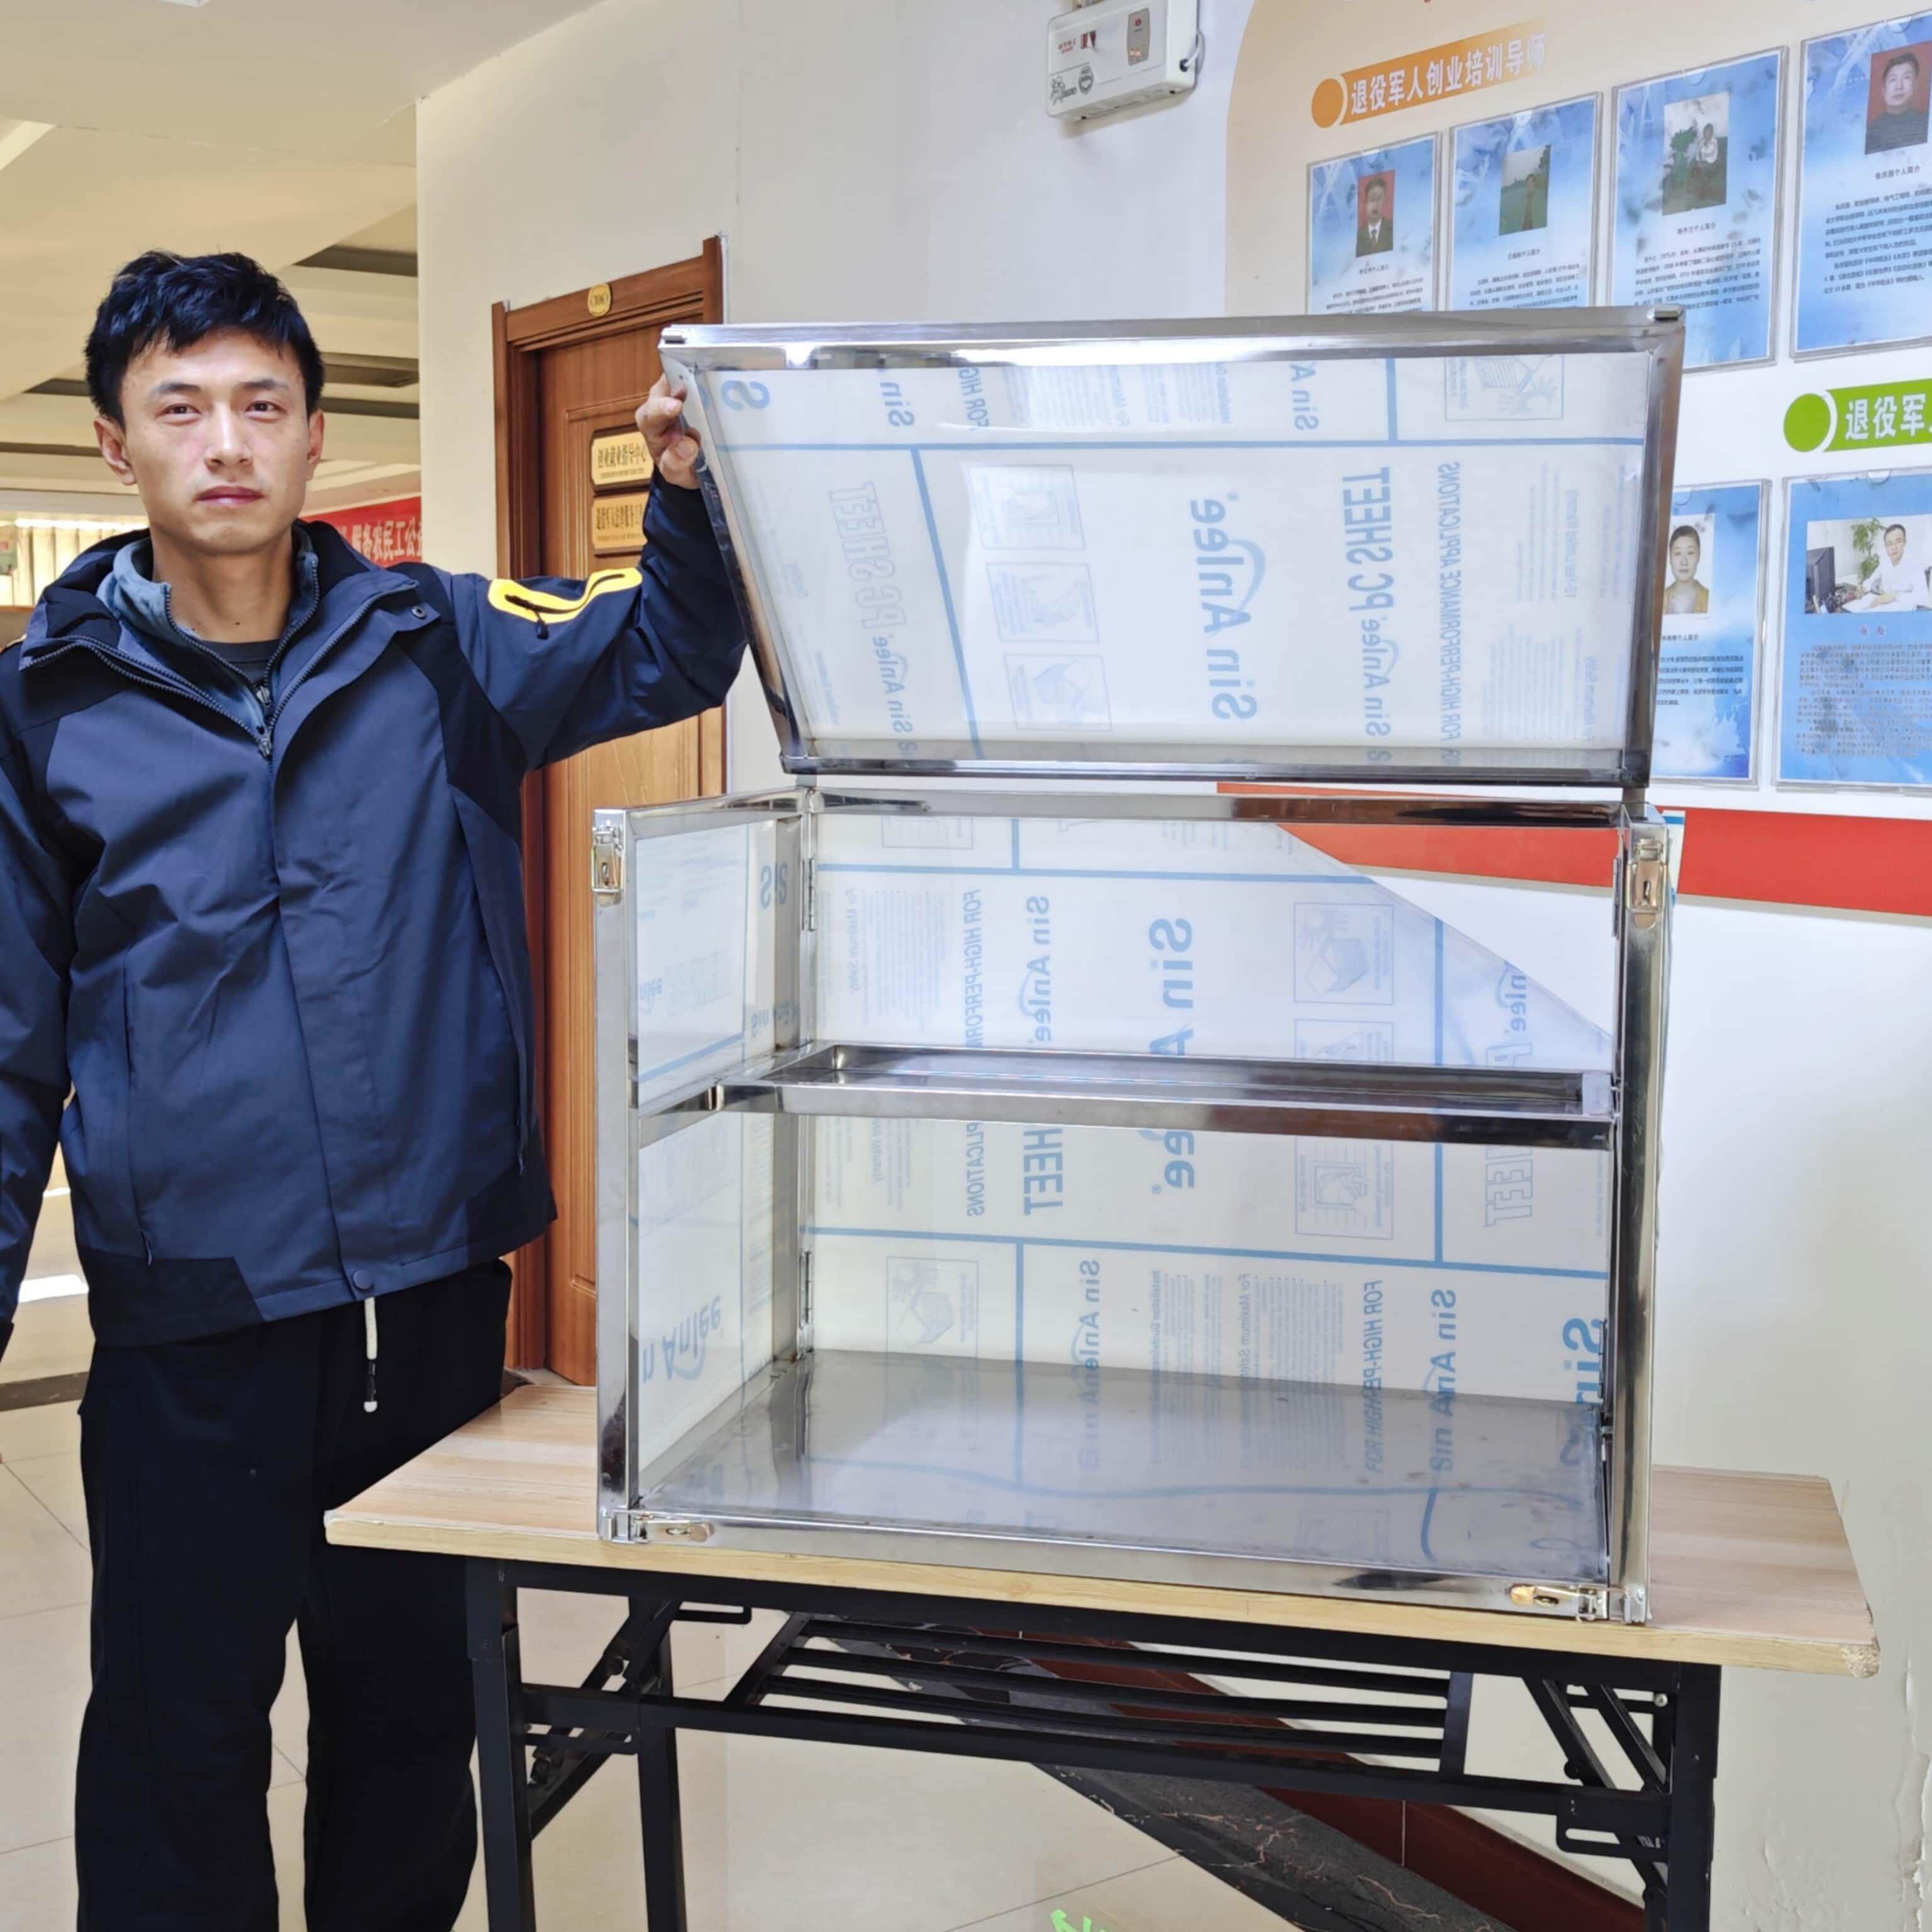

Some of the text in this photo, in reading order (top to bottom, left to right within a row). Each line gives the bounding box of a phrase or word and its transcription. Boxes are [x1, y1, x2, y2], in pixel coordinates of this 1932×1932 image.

[1350, 33, 1545, 115] 退役军人创业培训导师
[1845, 393, 1932, 440] 退役军
